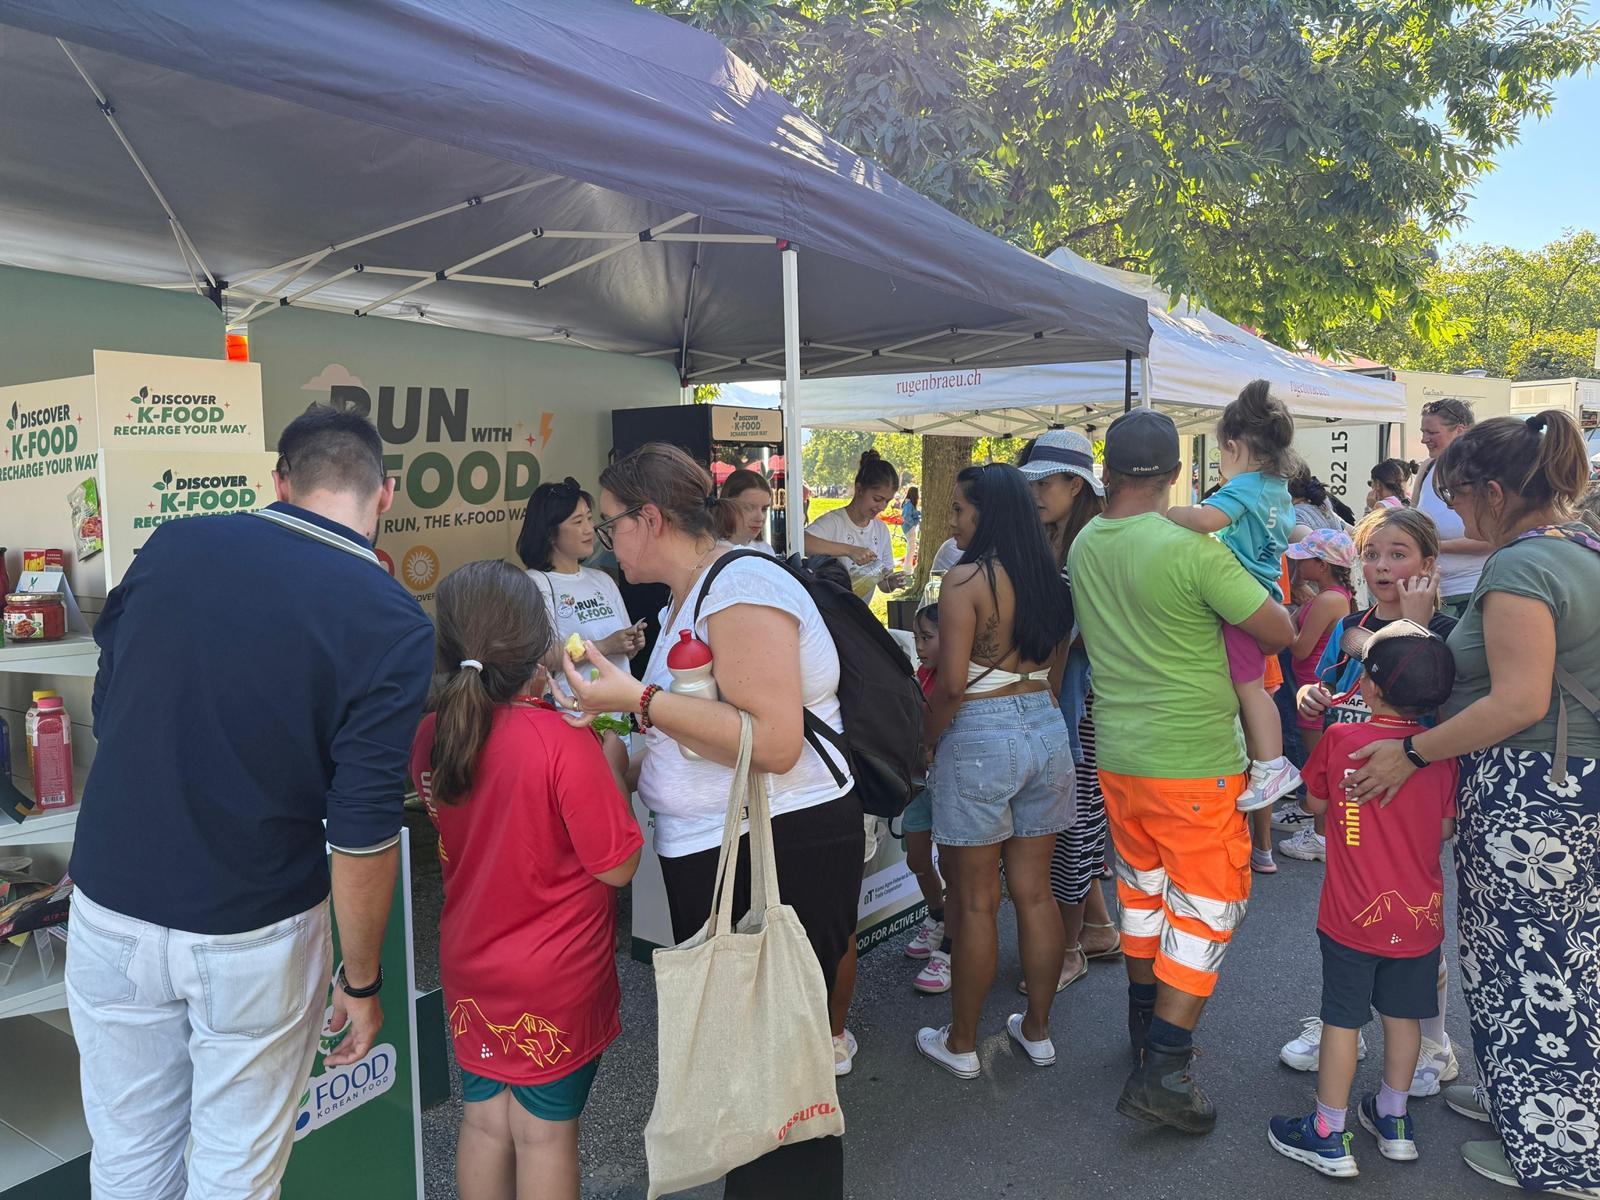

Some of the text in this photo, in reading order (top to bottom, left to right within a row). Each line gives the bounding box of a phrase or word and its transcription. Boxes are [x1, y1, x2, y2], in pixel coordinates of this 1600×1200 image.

[896, 369, 981, 397] rugenbraeu.ch
[152, 394, 216, 405] DISCOVER
[20, 403, 70, 429] DISCOVER
[137, 406, 224, 424] K-FOOD
[735, 421, 761, 430] K-FOOD
[114, 424, 247, 436] RECHARGE YOUR WAY
[472, 427, 512, 442] WITH
[11, 424, 78, 461] K-FOOD
[45, 457, 72, 475] YOUR
[74, 453, 98, 471] WAY
[1330, 430, 1348, 496] 822 15
[175, 475, 248, 491] DISCOVER
[160, 488, 256, 513] K-FOOD
[384, 507, 526, 533] RUN, THE K-FOOD WA
[577, 598, 599, 611] RUN
[577, 606, 613, 622] K-FOOD
[871, 925, 887, 943] FOR
[889, 912, 915, 935] ACTIVE
[915, 904, 929, 920] LIFE
[316, 1053, 389, 1110] FOOD
[316, 1075, 389, 1119] KOREAN FOOD
